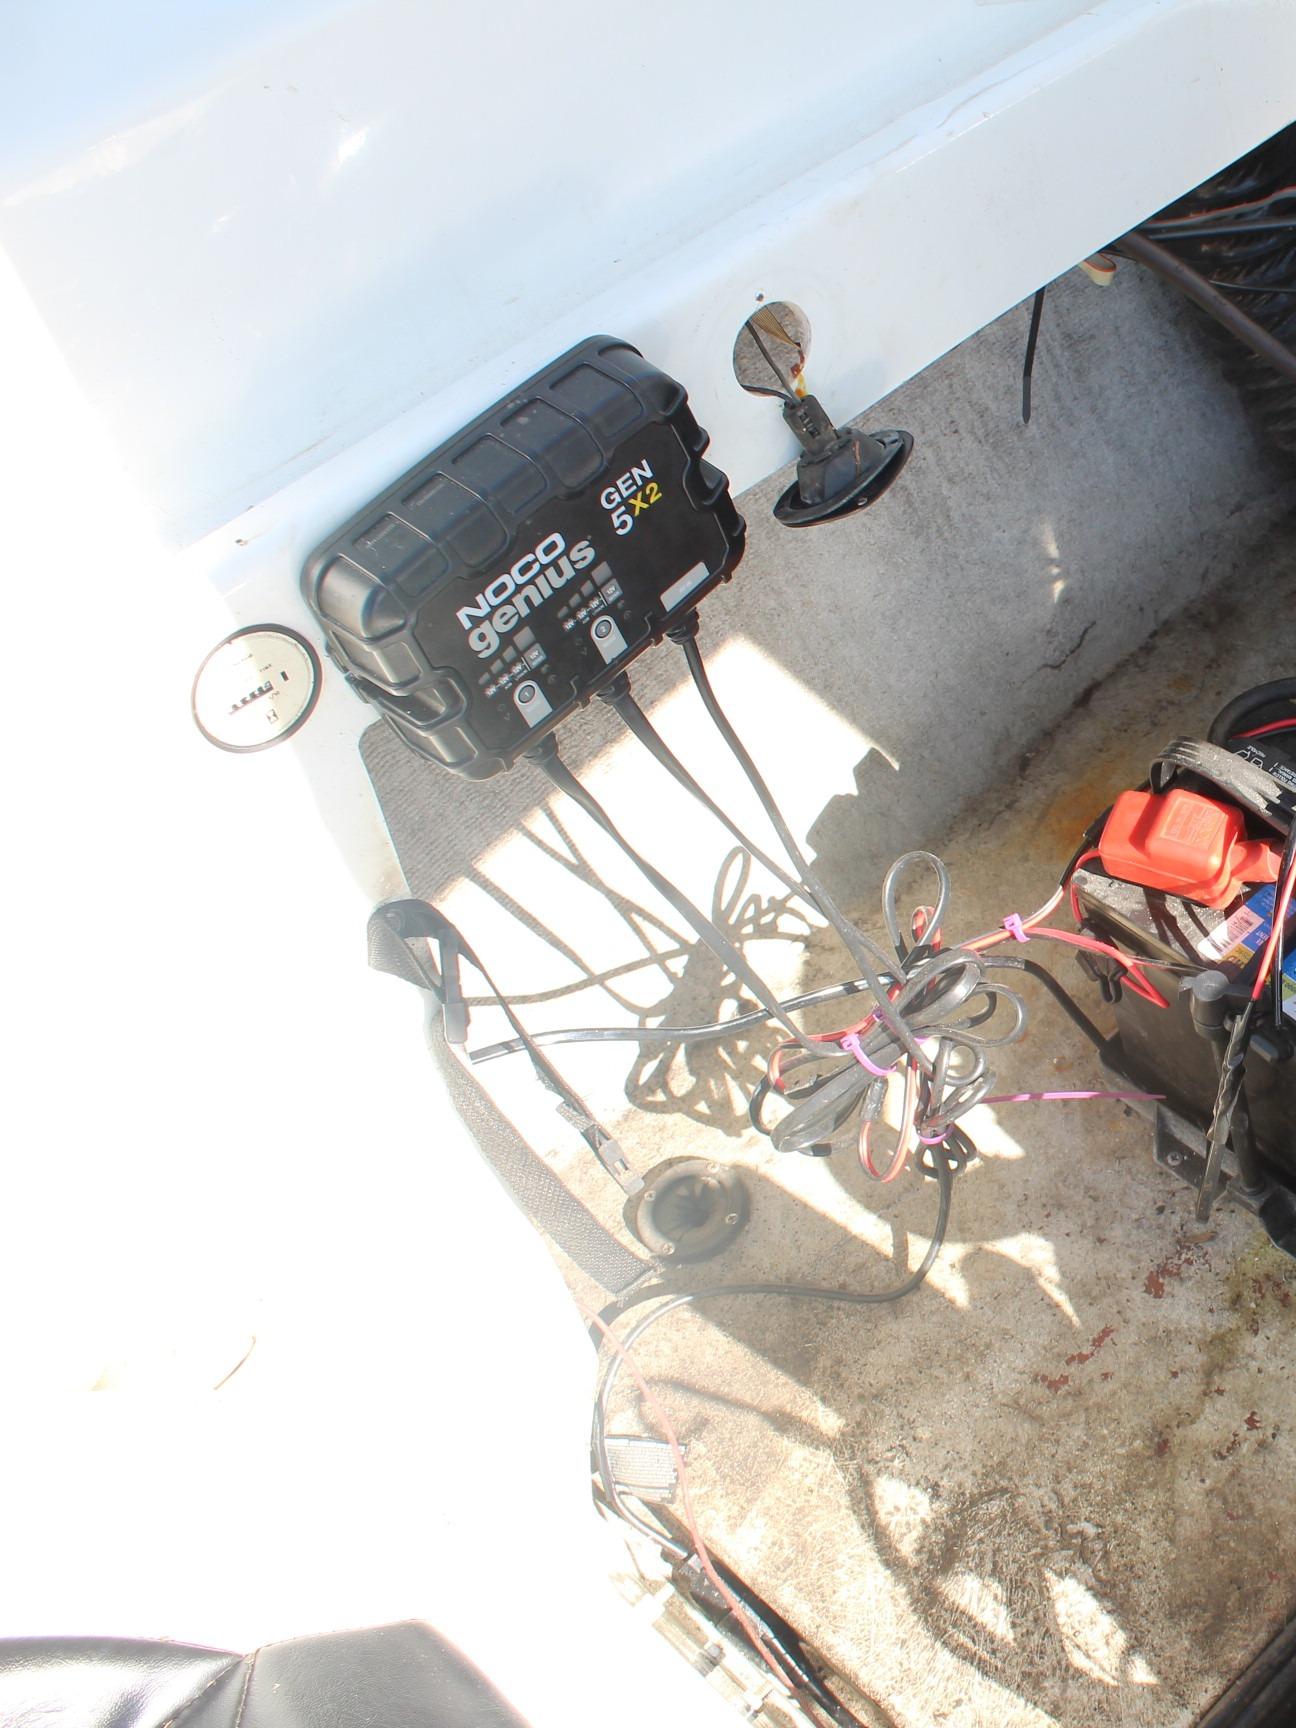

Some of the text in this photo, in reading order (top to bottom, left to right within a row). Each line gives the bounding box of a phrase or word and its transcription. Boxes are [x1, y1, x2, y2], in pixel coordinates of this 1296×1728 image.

[600, 459, 654, 511] GEN
[611, 482, 663, 535] 5X2
[456, 532, 566, 629] NOCO
[468, 539, 596, 659] genius
[529, 650, 539, 659] 12V
